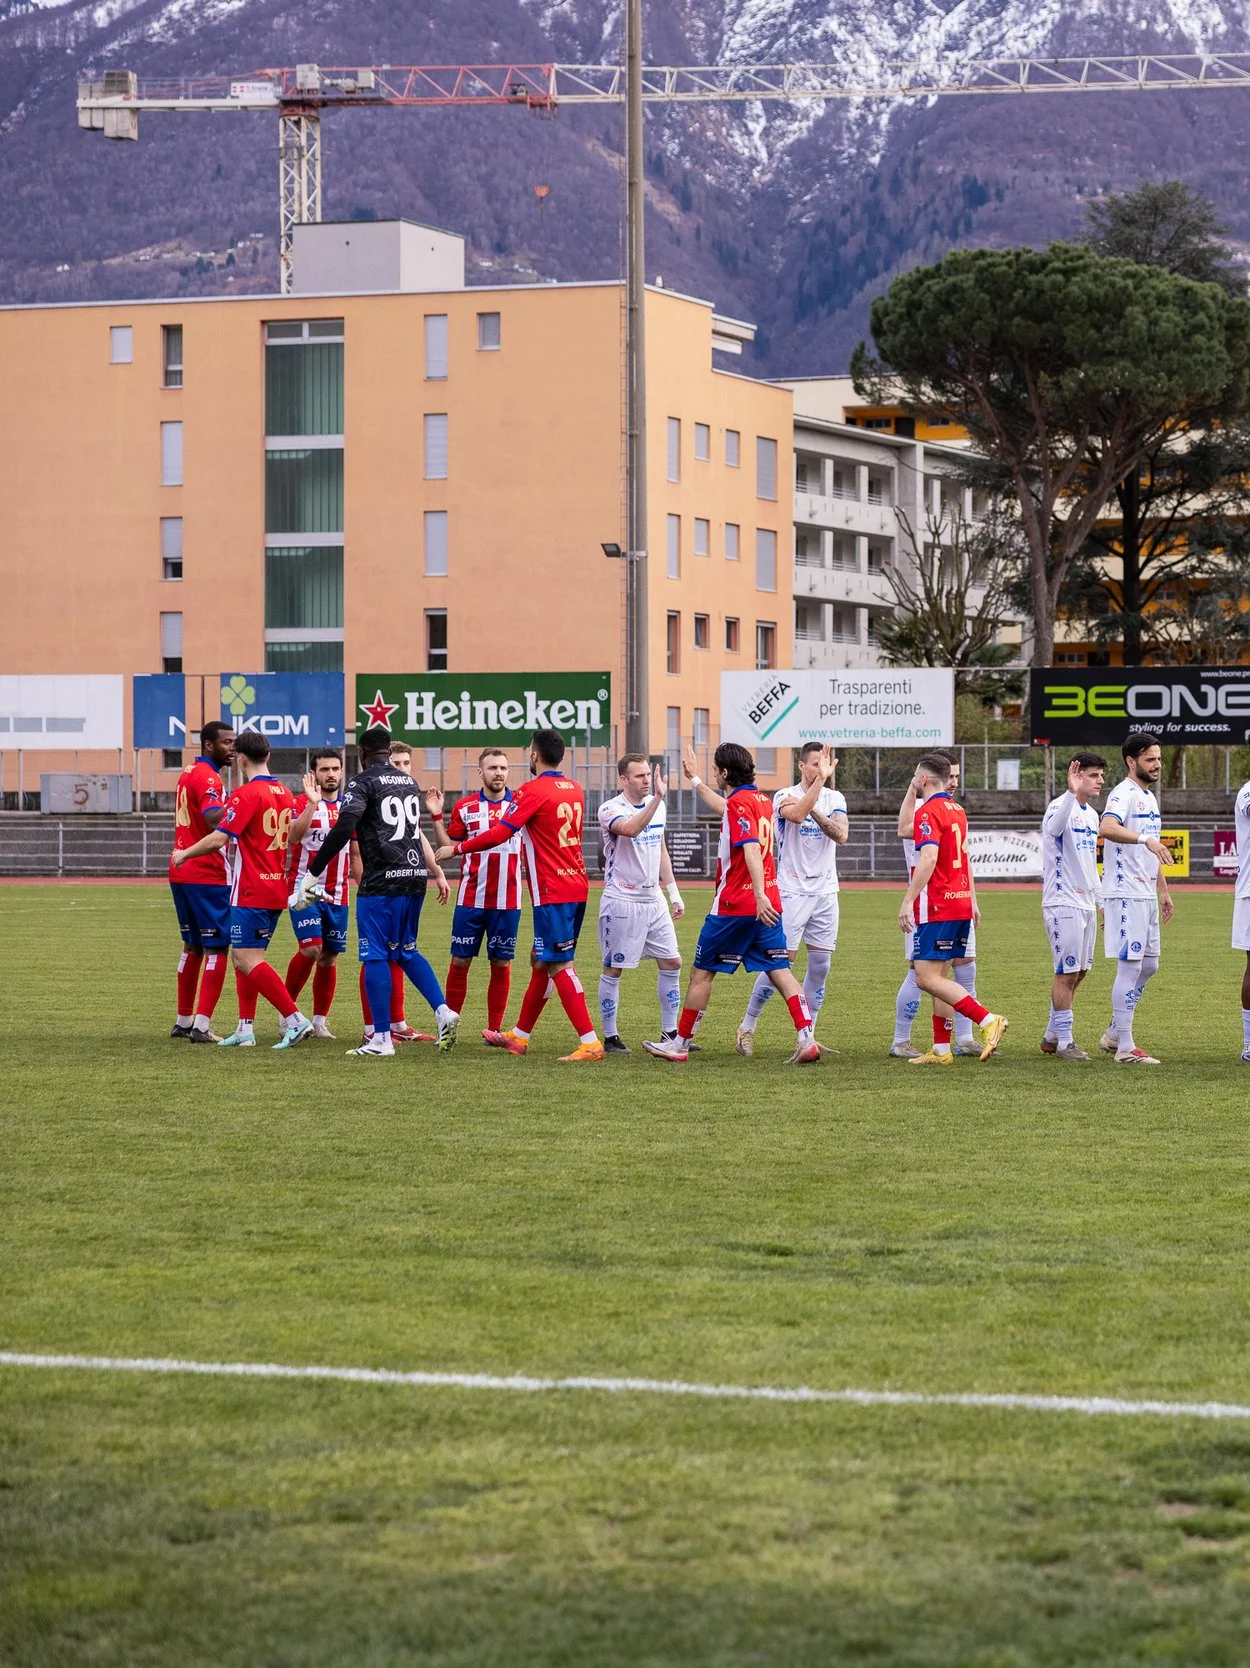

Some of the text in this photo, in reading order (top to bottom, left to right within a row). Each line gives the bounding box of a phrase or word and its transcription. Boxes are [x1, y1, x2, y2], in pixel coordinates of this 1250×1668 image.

[741, 673, 778, 713] VETRERIA
[829, 678, 912, 696] Trasparenti
[748, 680, 791, 724] BEFFA
[820, 699, 926, 719] per tradizione.
[798, 726, 941, 739] www.vetreria-beffa.com
[1129, 722, 1231, 734] styling for success.
[379, 775, 414, 785] NGONGO
[74, 783, 89, 805] 5
[329, 809, 340, 820] 15
[381, 794, 420, 842] 99
[488, 809, 502, 820] 24
[262, 806, 293, 851] 98
[1003, 835, 1040, 854] PIZZERIA
[969, 852, 1028, 865] anorama
[385, 869, 413, 879] ROBERT
[452, 935, 475, 945] PART
